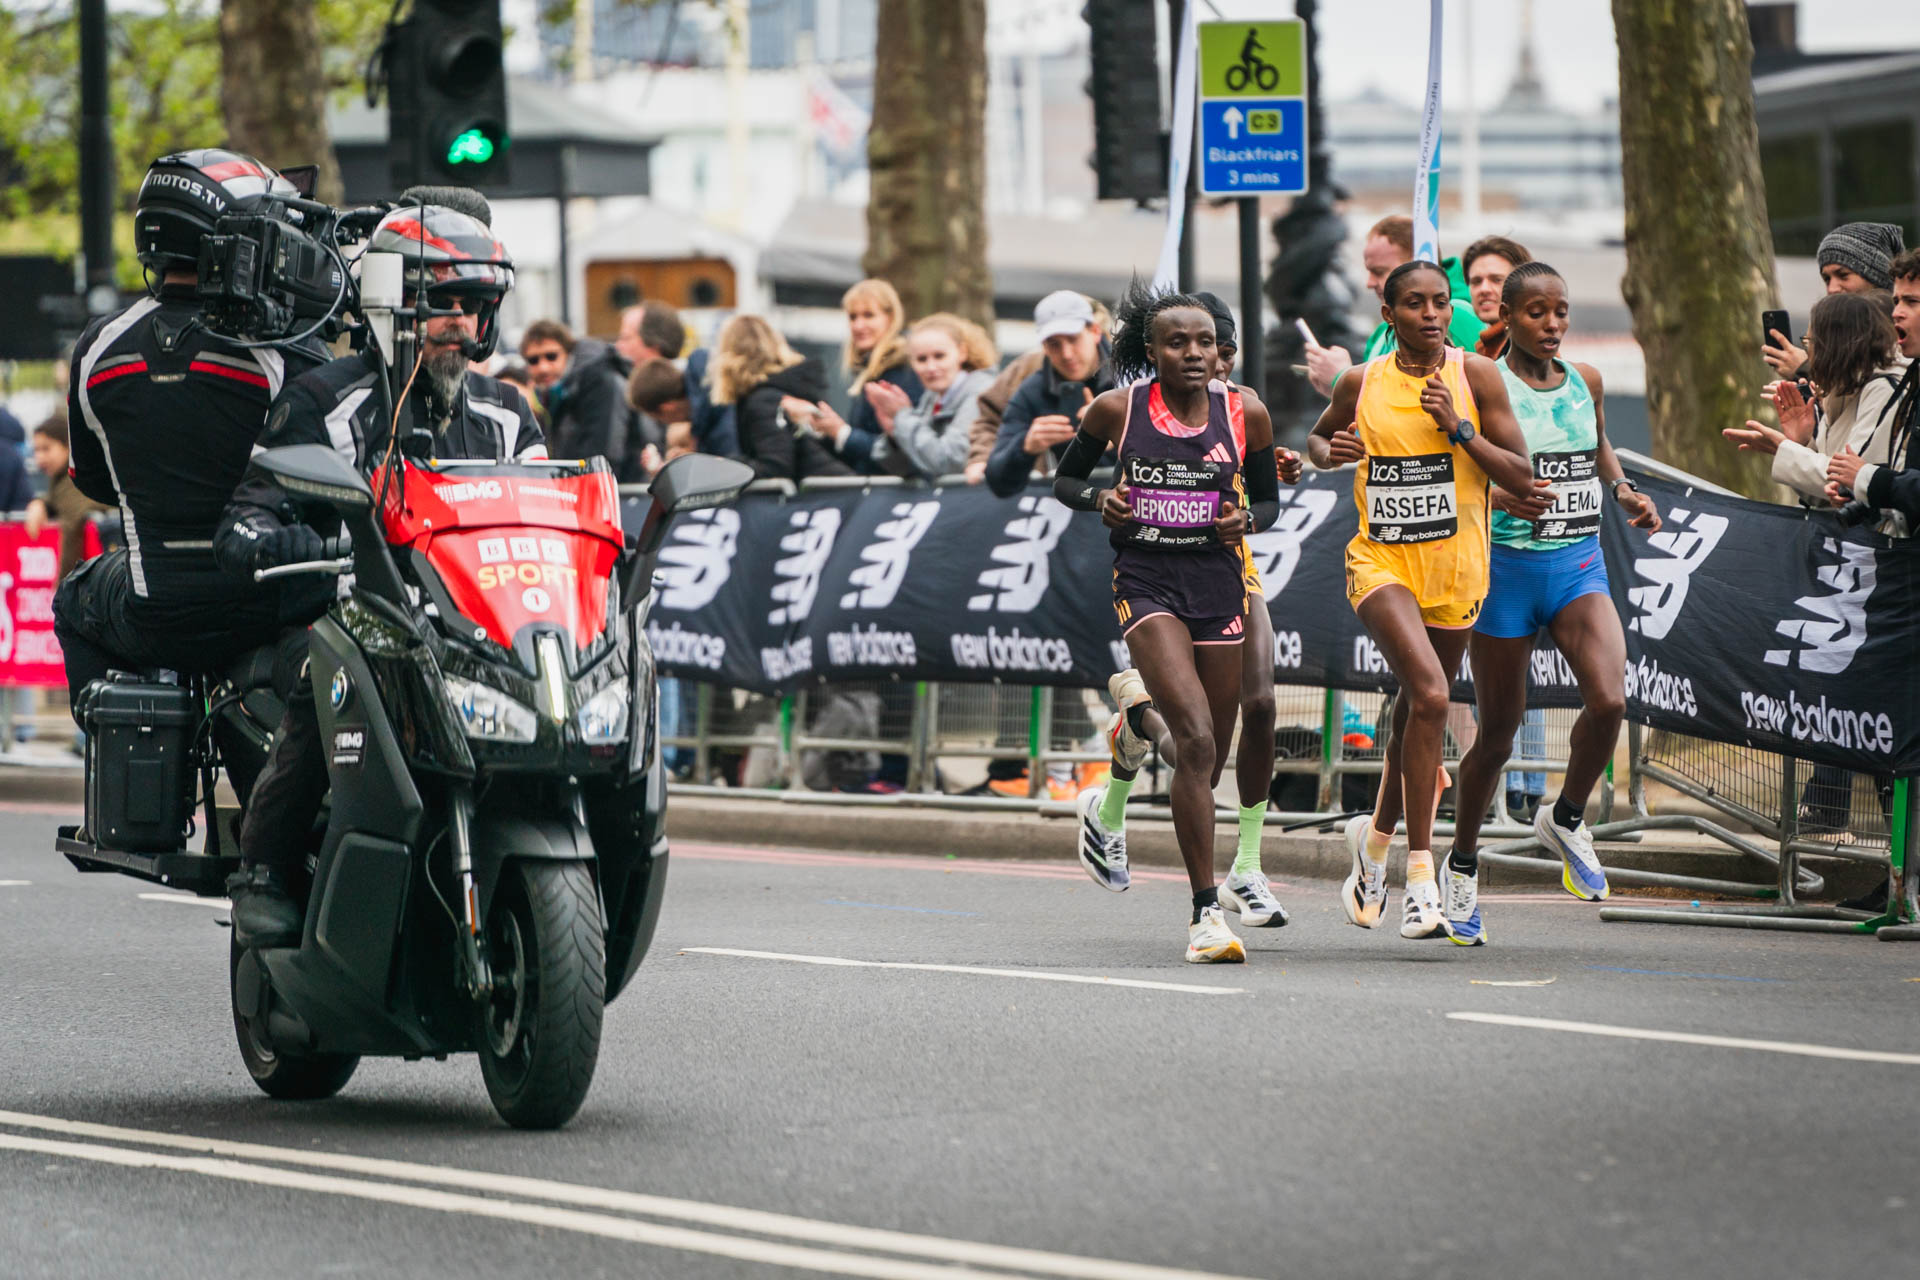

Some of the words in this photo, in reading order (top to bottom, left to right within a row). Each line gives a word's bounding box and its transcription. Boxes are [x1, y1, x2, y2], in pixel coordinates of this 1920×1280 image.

[1251, 114, 1279, 129] C3
[1209, 147, 1299, 163] Blackfriars
[1228, 170, 1239, 185] 3
[1242, 171, 1280, 185] mins
[1132, 461, 1163, 484] tcs
[1371, 460, 1399, 482] tcs
[1400, 460, 1422, 468] TATA
[1401, 464, 1448, 475] CONSULTANCY
[1539, 457, 1569, 478] tcs
[1166, 471, 1215, 480] CONSULTANCY
[1166, 478, 1197, 486] SERVICES
[1402, 473, 1432, 482] SERVICES
[1132, 497, 1213, 524] JEPKOSGEI
[1373, 494, 1451, 518] ASSEFA
[1176, 535, 1208, 544] balance
[1418, 529, 1451, 539] balance
[478, 563, 577, 590] SPORT
[951, 633, 989, 668] new
[988, 625, 1073, 672] balance
[1354, 635, 1393, 674] ne
[1638, 654, 1698, 717] balance
[1740, 691, 1788, 735] new
[1789, 689, 1893, 754] balance
